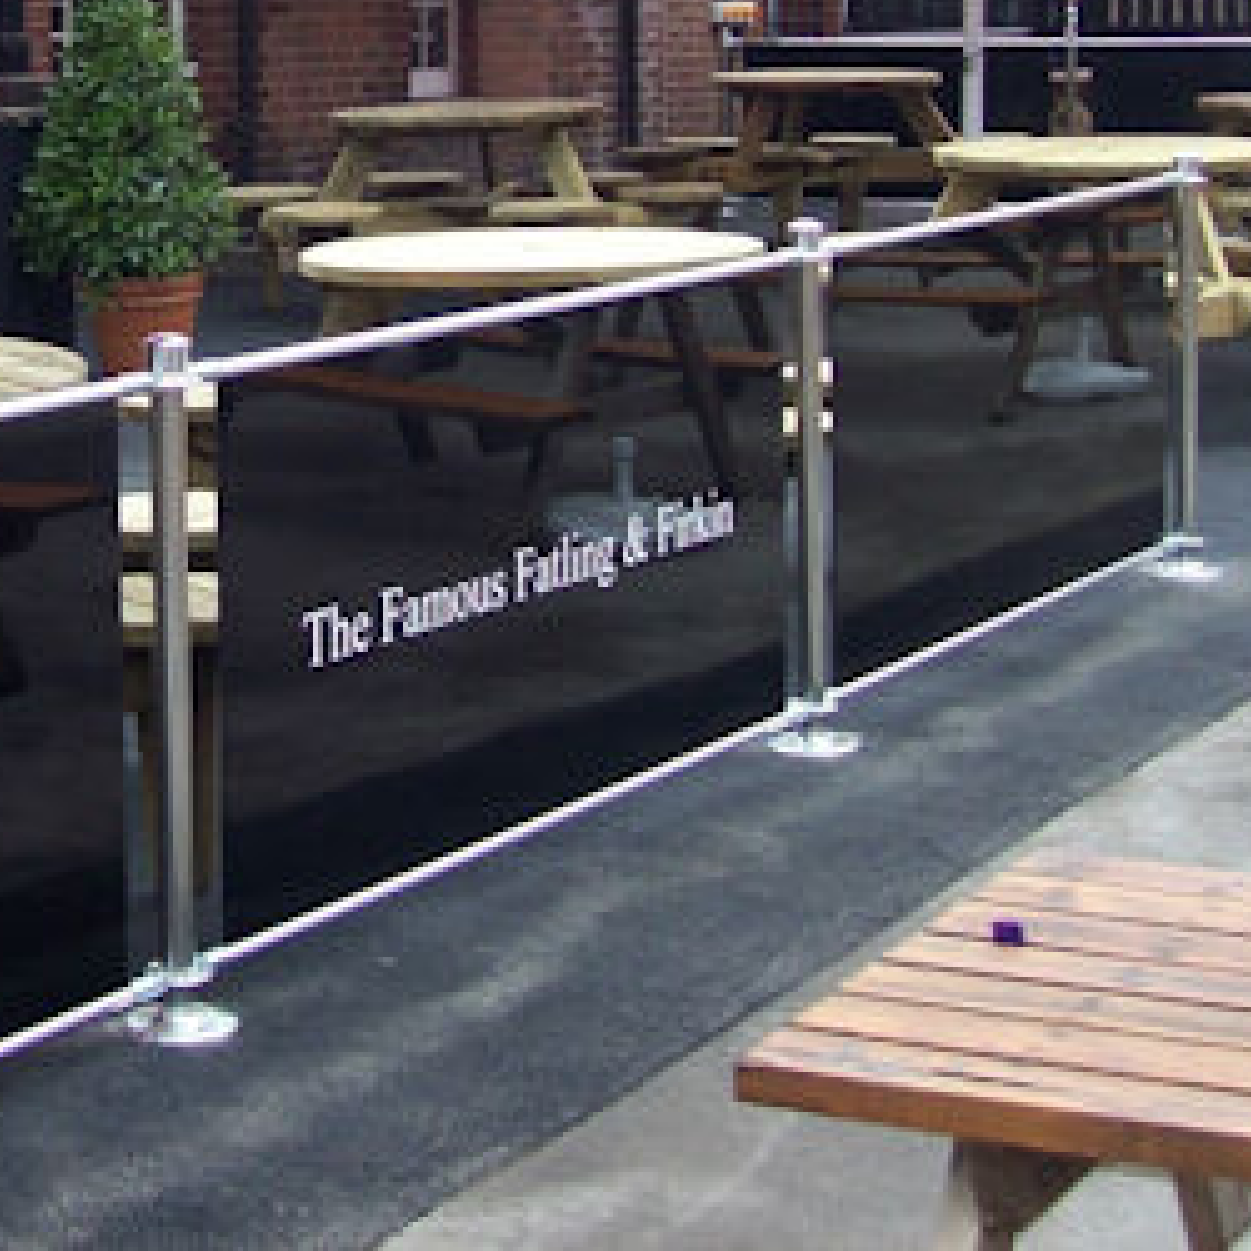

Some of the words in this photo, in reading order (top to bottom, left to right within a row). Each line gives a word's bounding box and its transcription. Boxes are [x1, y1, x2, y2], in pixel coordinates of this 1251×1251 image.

[302, 603, 370, 667] The
[381, 570, 509, 643] Famous
[513, 531, 619, 602] Fatling
[622, 514, 650, 568] &
[656, 488, 735, 557] Firkin
